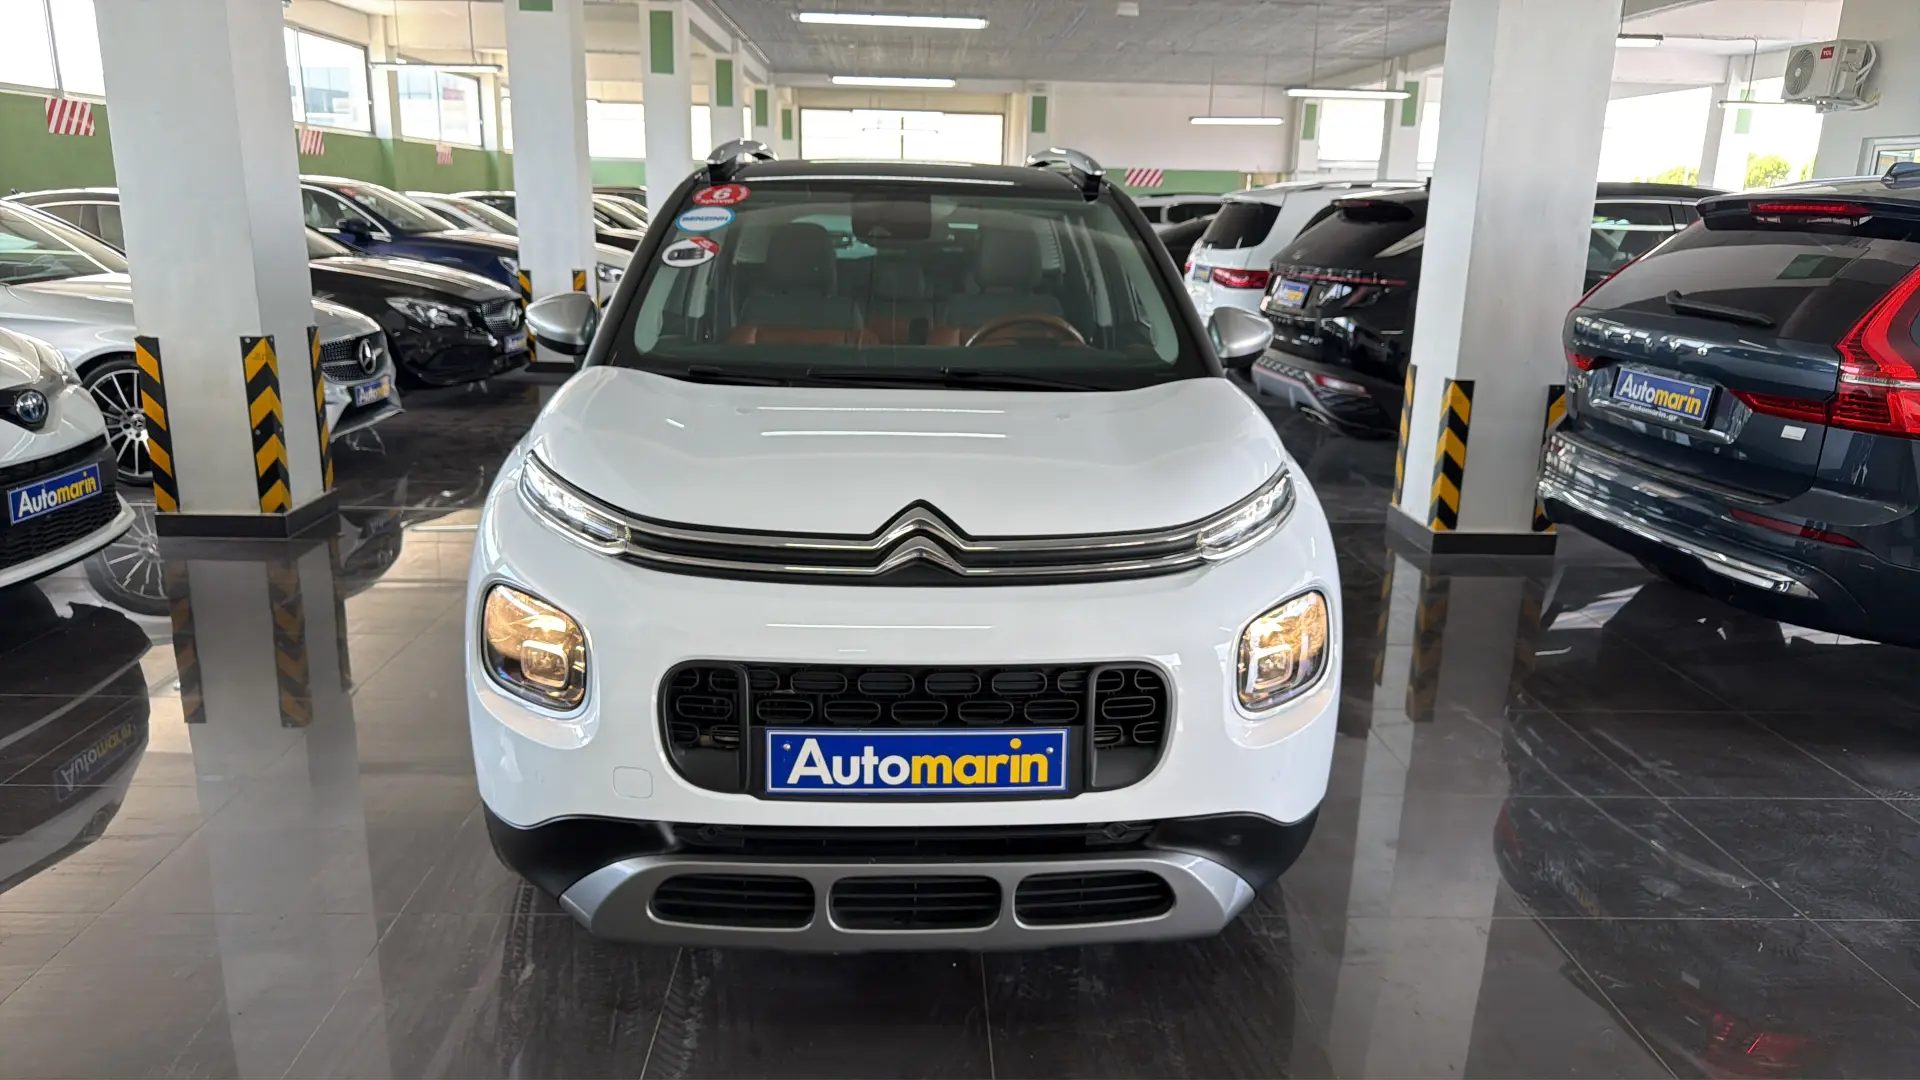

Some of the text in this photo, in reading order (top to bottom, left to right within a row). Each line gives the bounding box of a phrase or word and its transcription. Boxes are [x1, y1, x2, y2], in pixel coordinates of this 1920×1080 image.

[1619, 373, 1702, 416] Automarin
[18, 471, 97, 518] Automarin
[786, 737, 1049, 785] Automarin
